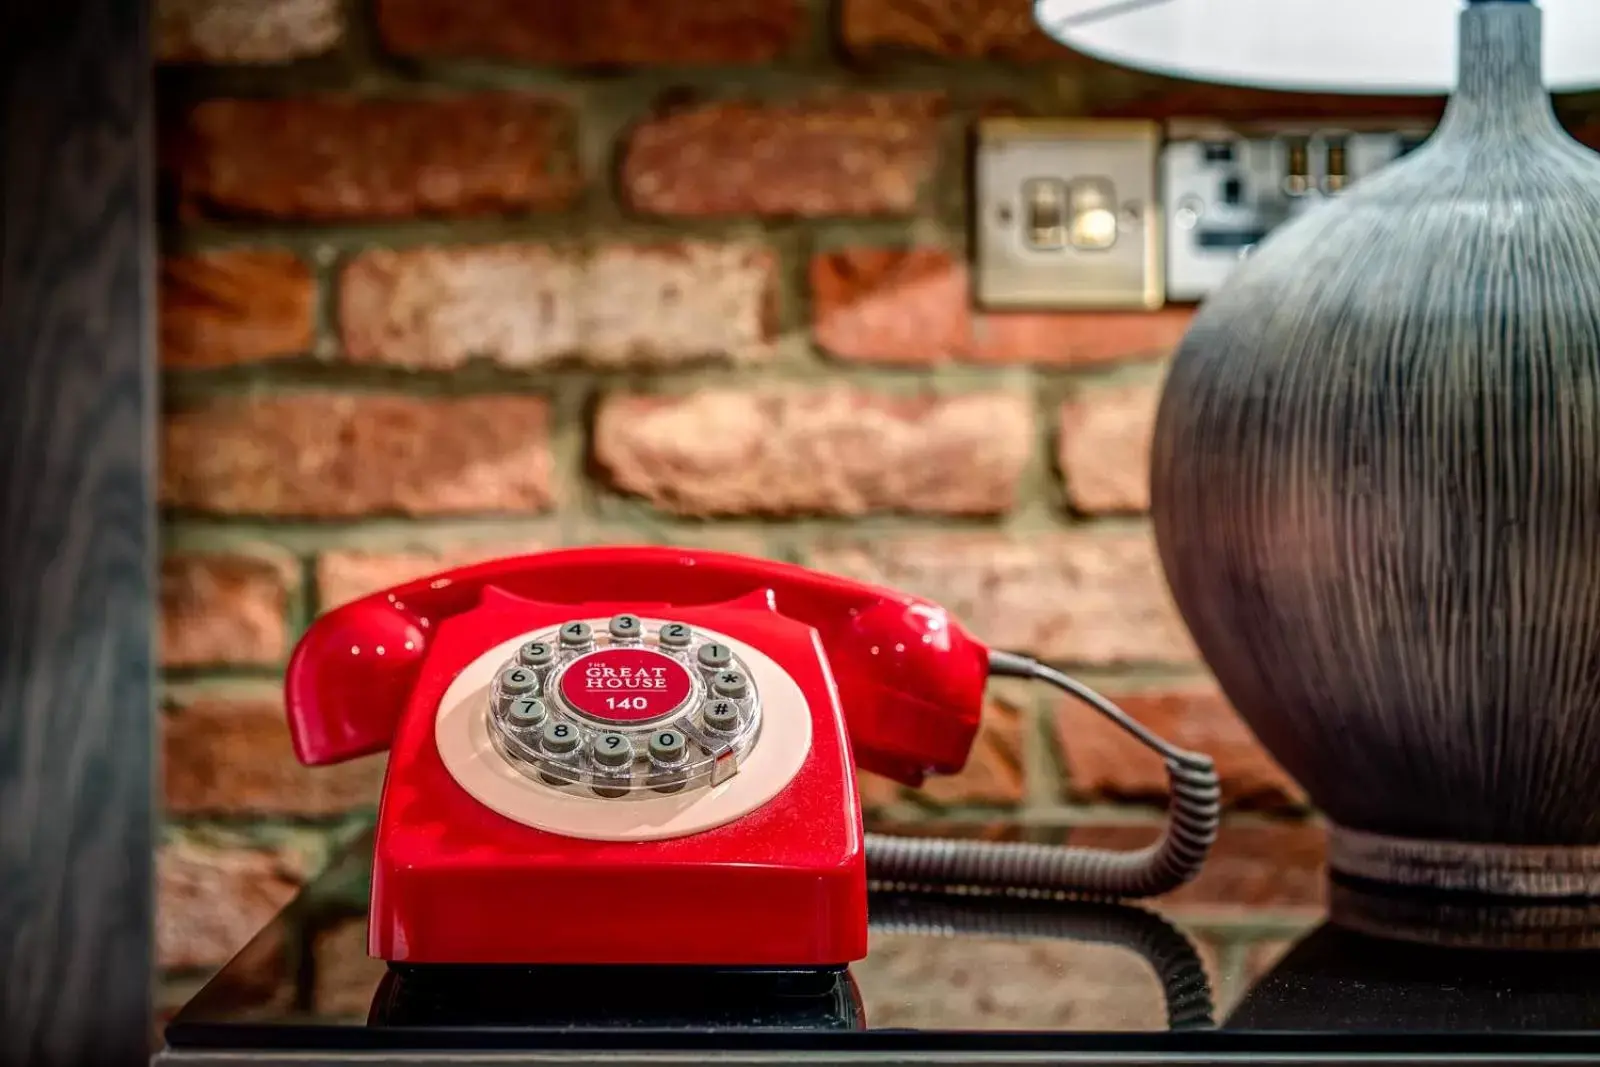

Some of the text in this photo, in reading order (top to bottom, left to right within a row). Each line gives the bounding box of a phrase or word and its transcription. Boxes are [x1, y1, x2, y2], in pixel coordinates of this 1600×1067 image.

[619, 616, 633, 629] 3
[567, 624, 582, 635] 4
[669, 624, 683, 637] 2
[531, 643, 545, 655] 5
[710, 645, 718, 657] 1
[511, 670, 526, 682] 6
[585, 667, 667, 678] GREAT
[585, 678, 667, 688] HOUSE
[521, 701, 536, 713] 7
[606, 697, 648, 710] 140
[554, 724, 569, 737] 8
[605, 737, 620, 749] 9
